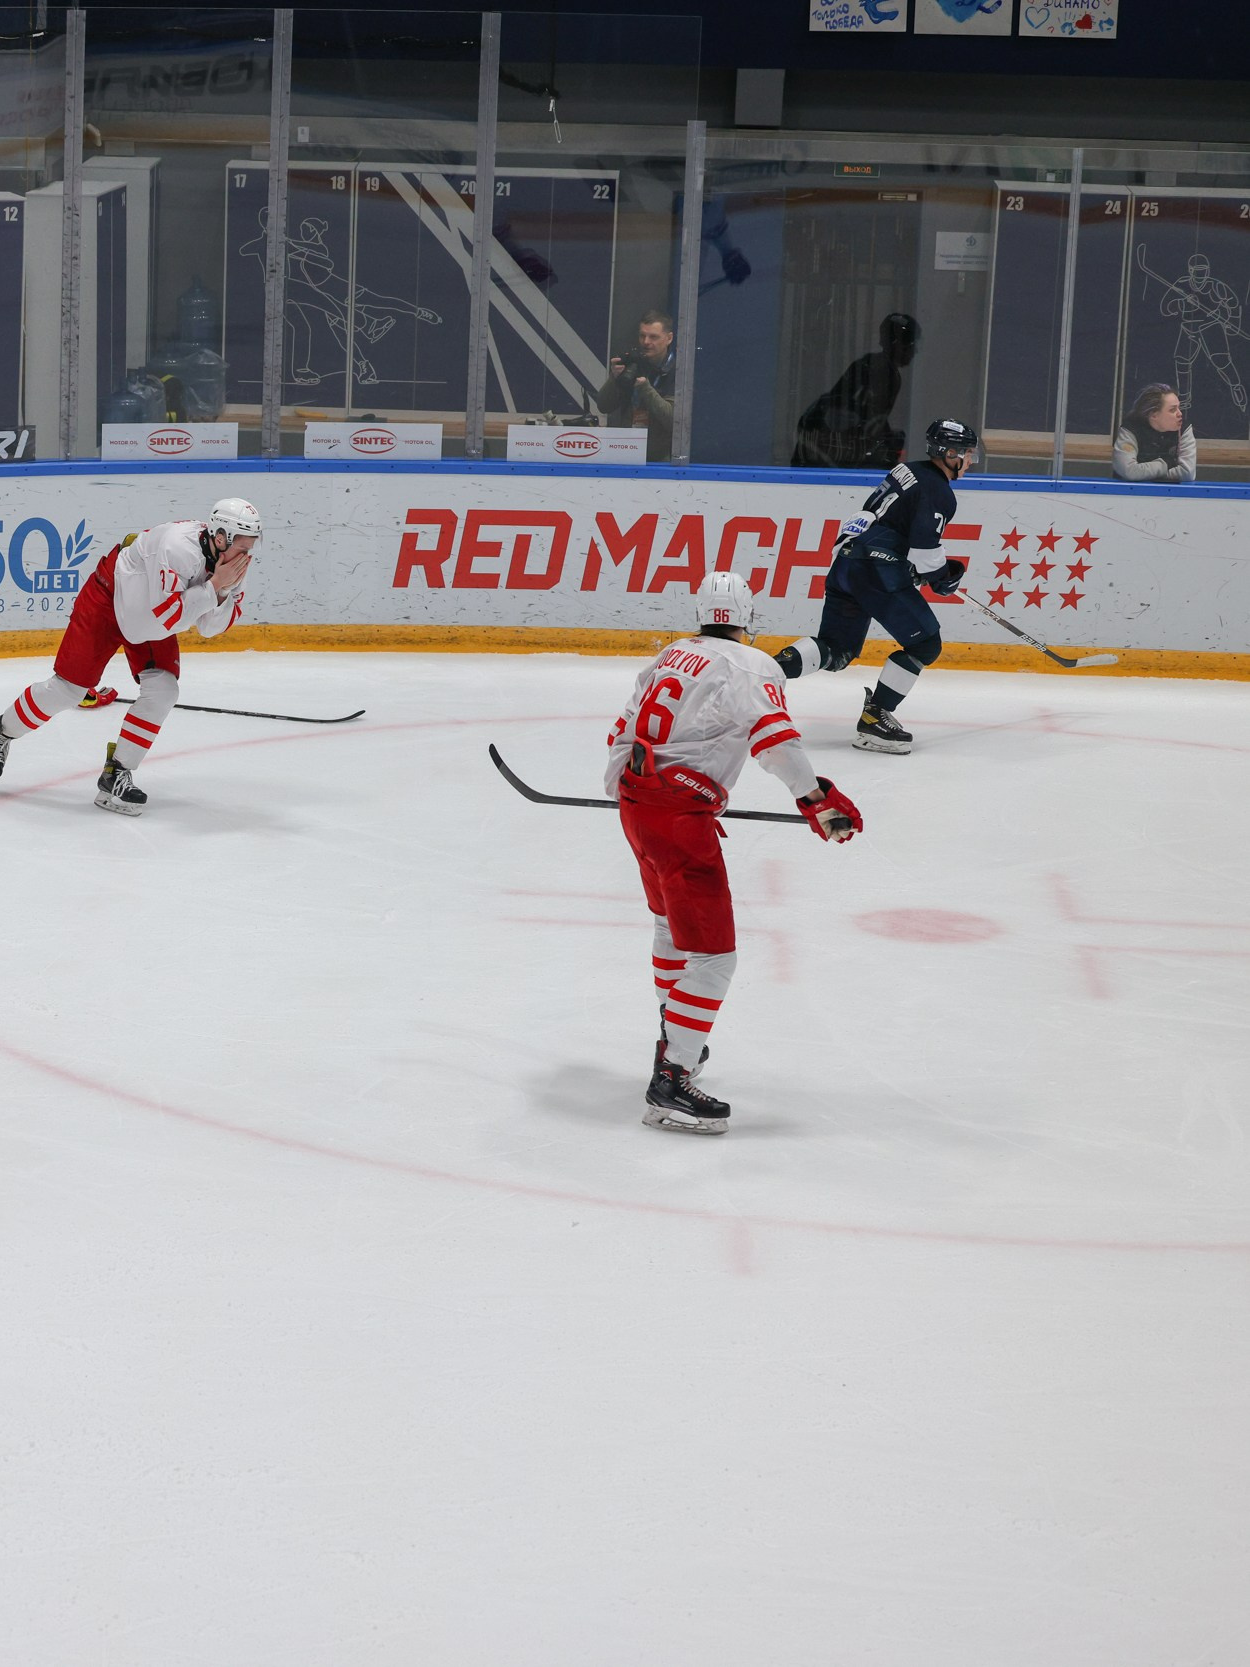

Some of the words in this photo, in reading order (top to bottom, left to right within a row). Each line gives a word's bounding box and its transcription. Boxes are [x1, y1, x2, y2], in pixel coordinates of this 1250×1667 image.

[825, 15, 864, 30] ПОБЕДА
[844, 165, 872, 174] ВЫХОД
[234, 174, 247, 188] 17
[330, 176, 345, 190] 18
[365, 177, 380, 192] 19
[496, 182, 511, 197] 21
[593, 184, 609, 199] 22
[1006, 196, 1024, 211] 23
[1105, 200, 1121, 216] 24
[1141, 202, 1159, 217] 25
[3, 206, 18, 222] 12
[149, 437, 191, 446] SINTEC
[352, 436, 394, 446] SINTEC
[556, 440, 598, 450] SINTEC
[934, 512, 947, 537] 7
[392, 509, 573, 589] RED
[580, 511, 982, 604] MACHE
[37, 573, 76, 589] ЛЕТ
[713, 609, 730, 623] 86
[635, 675, 684, 746] 6
[674, 772, 717, 801] BAUER
